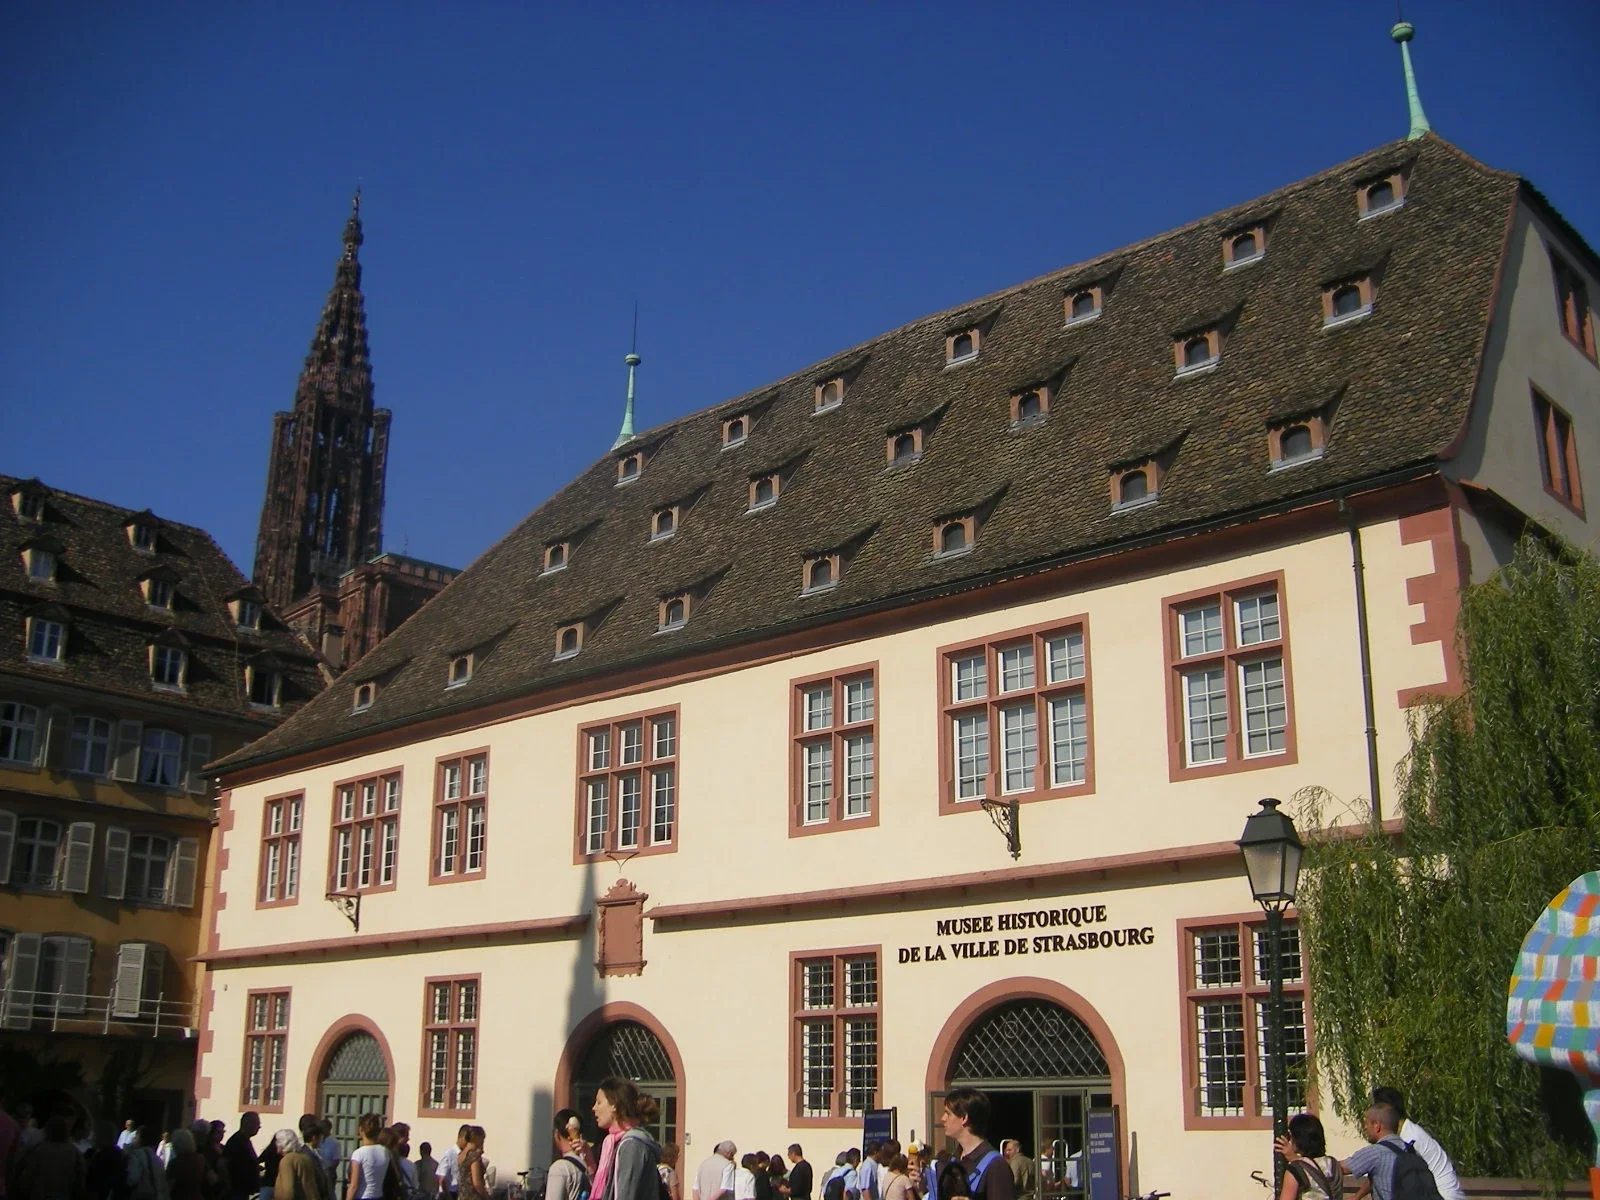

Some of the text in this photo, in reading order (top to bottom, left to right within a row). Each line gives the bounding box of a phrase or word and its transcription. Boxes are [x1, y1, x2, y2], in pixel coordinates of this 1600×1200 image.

[936, 905, 1107, 936] MUSEE HISTORIQUE
[898, 927, 1155, 964] DE LA VILLE DE STRASBOURG
